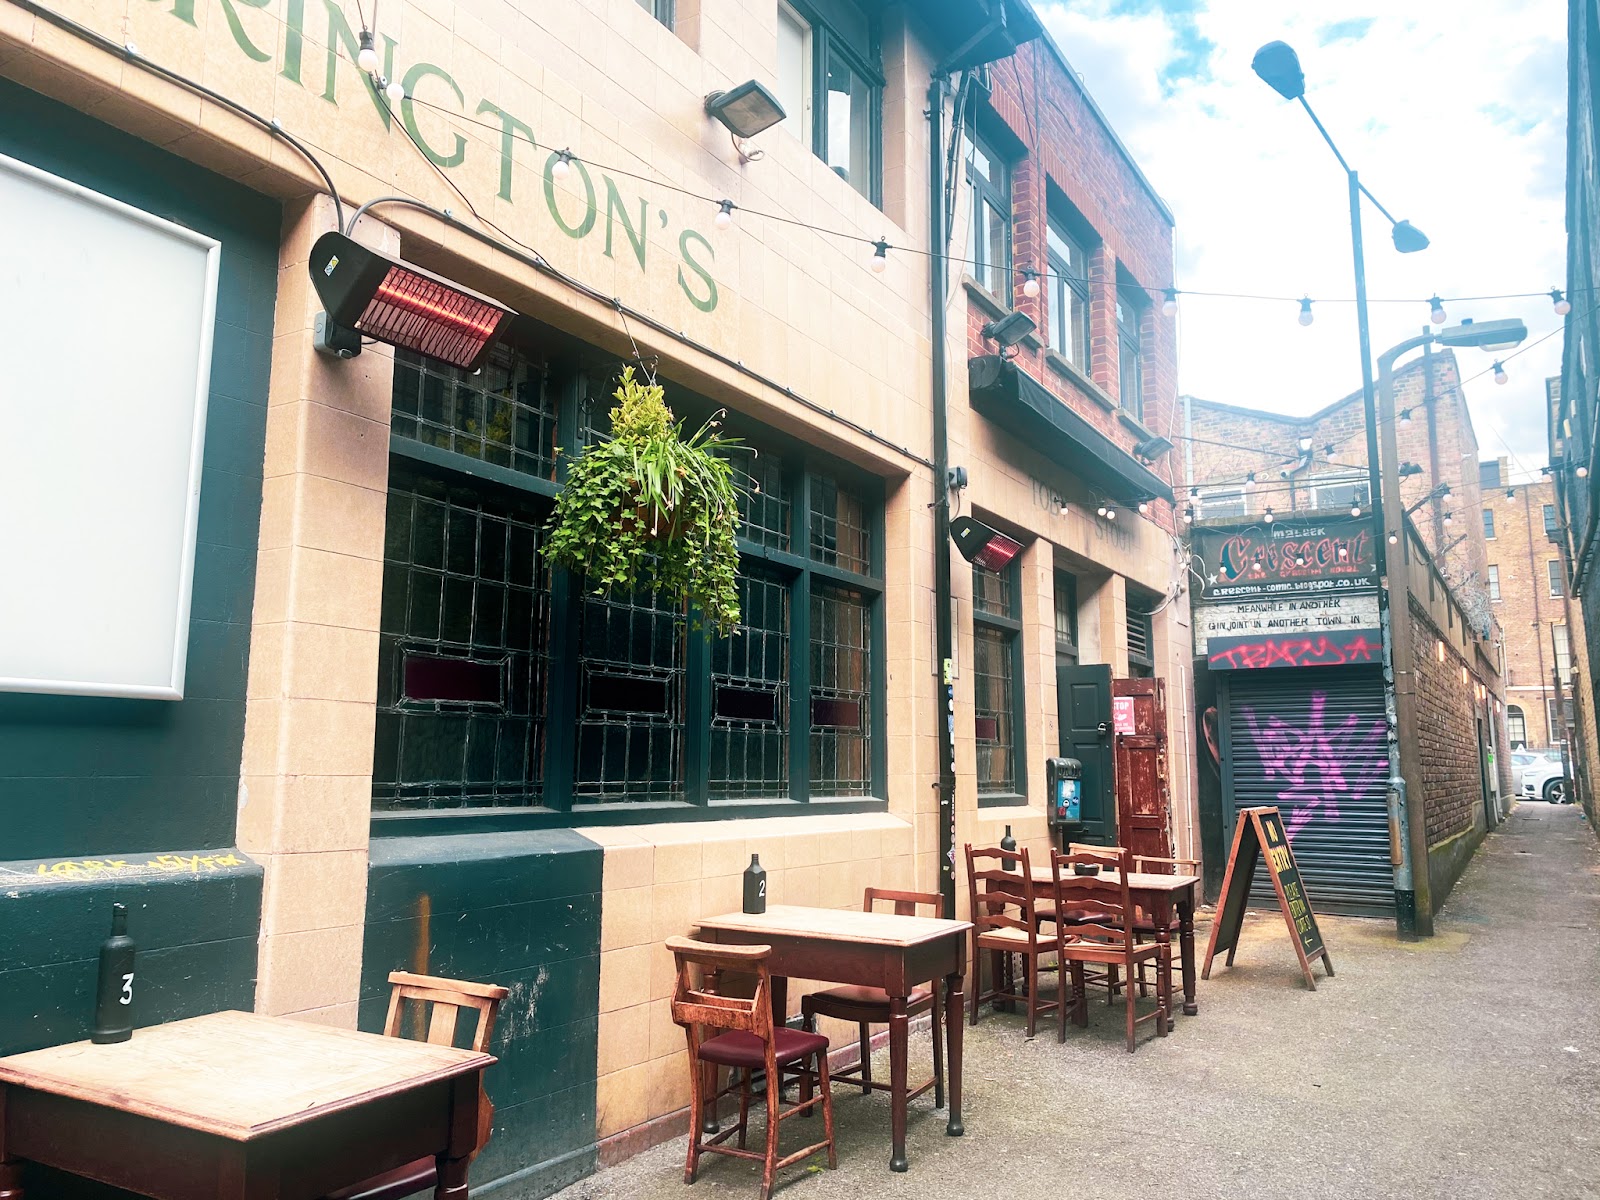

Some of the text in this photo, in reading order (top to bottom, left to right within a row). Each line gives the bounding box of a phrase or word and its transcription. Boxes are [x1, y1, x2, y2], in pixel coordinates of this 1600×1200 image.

[1219, 529, 1370, 583] Crescent
[1237, 602, 1283, 613] MEANWHILE
[1288, 602, 1297, 611] IN
[1227, 620, 1249, 631] JOINT
[1267, 617, 1309, 628] ANOTHER
[1317, 616, 1342, 626] TOWN
[1351, 615, 1360, 624] IN
[1265, 820, 1279, 842] NO
[1269, 845, 1292, 874] ENTRY
[759, 880, 766, 897] 2
[119, 973, 135, 1005] 3
